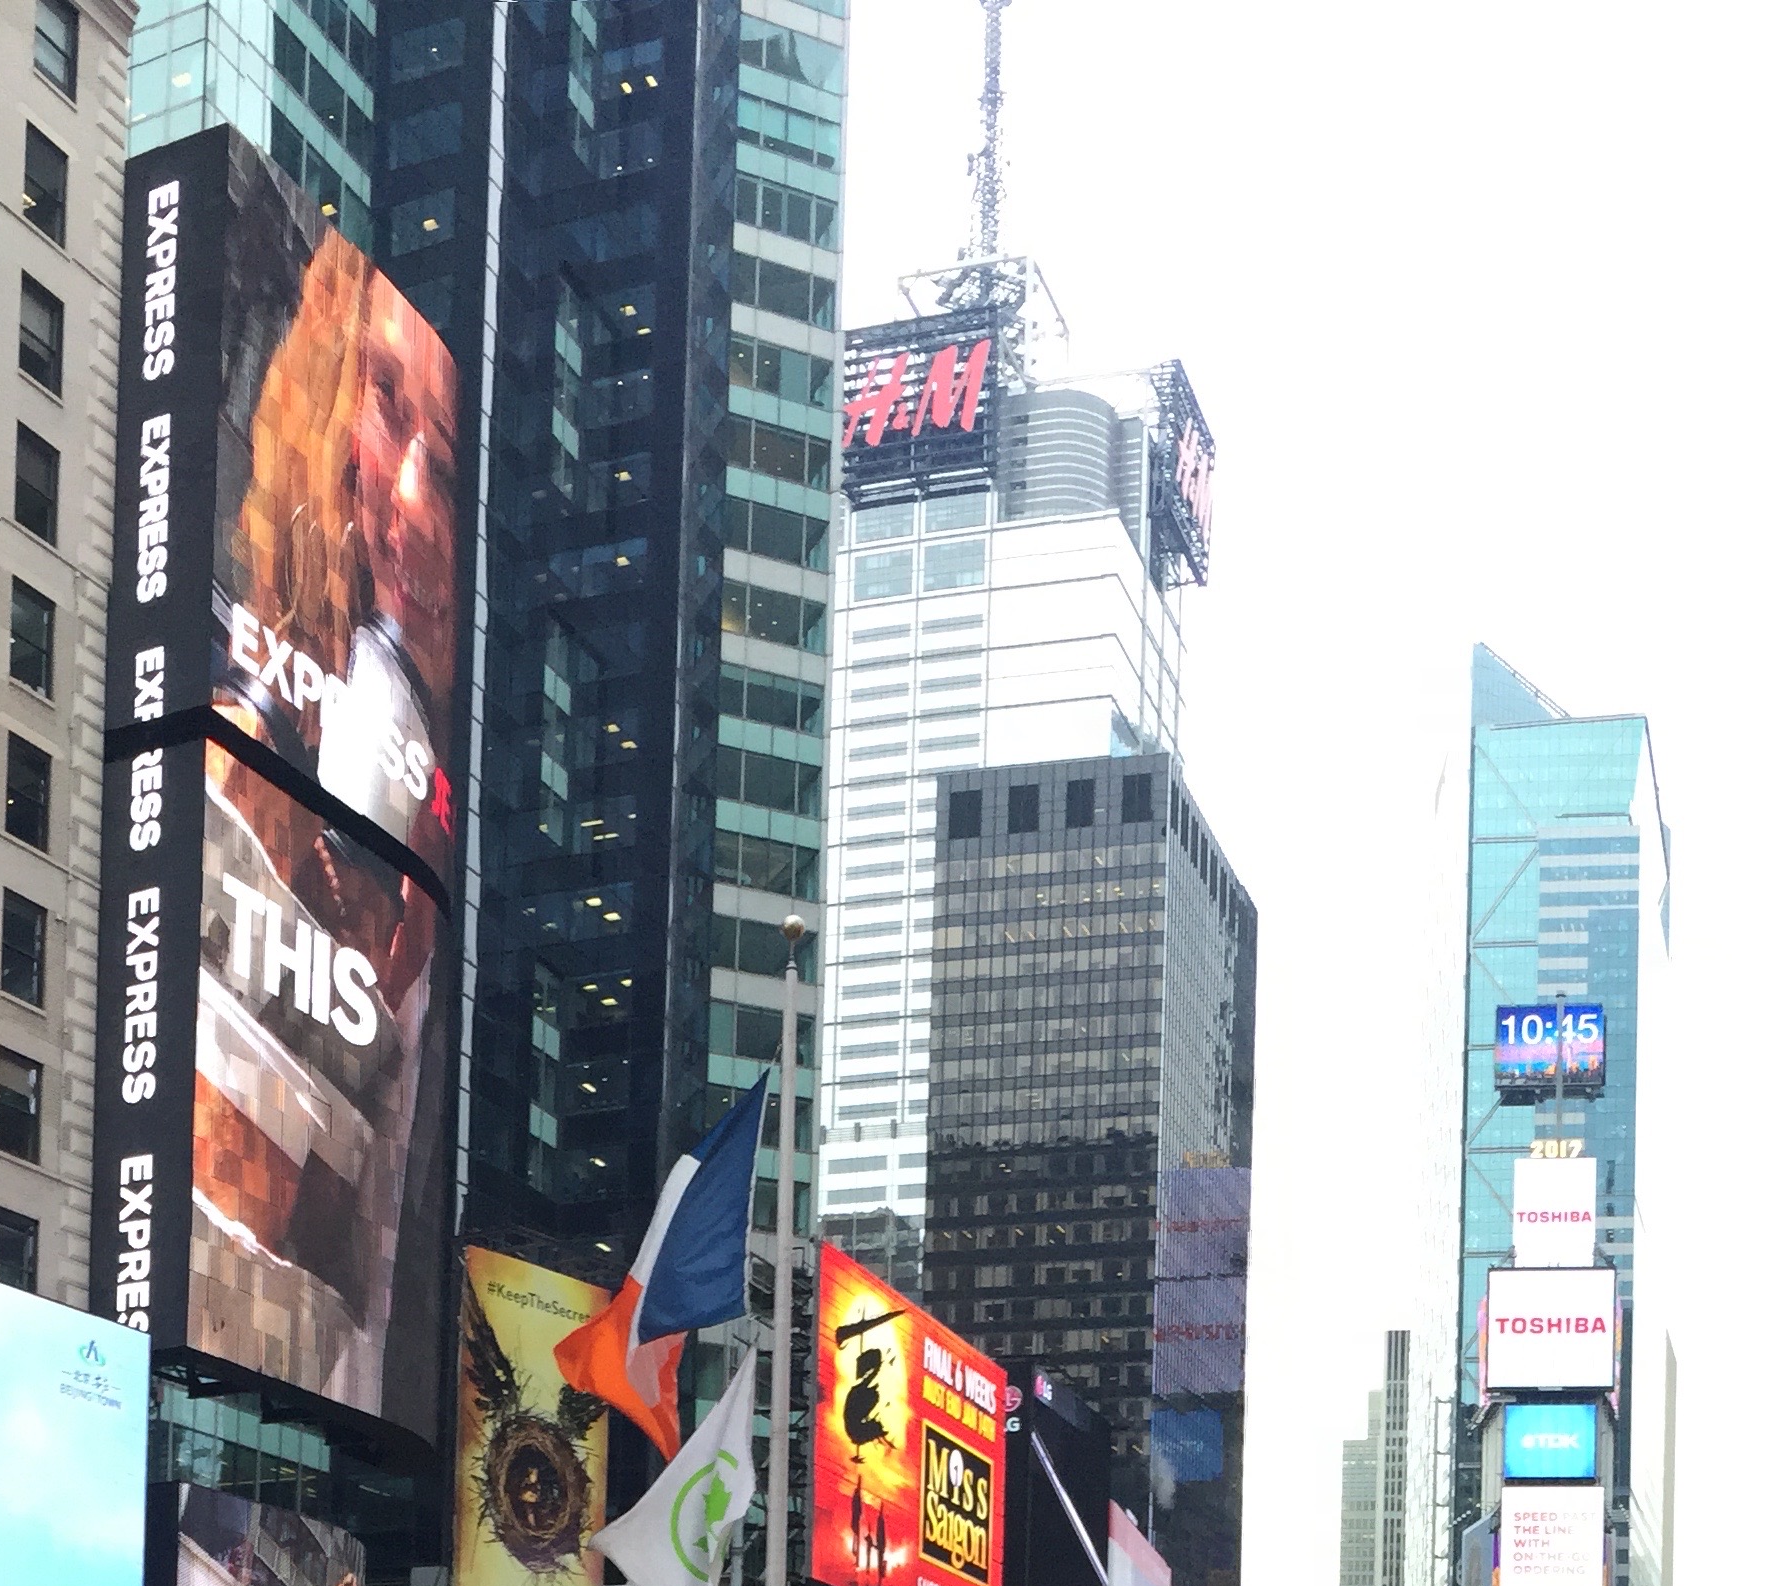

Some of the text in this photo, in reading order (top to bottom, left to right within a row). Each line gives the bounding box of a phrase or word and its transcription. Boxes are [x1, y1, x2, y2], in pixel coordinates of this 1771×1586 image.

[142, 180, 179, 381] EXPRESS
[842, 338, 991, 447] H&M
[136, 412, 170, 603] EXPRESS
[223, 872, 378, 1046] THIS
[122, 888, 160, 1103] EXPRESS
[1530, 1140, 1581, 1158] 2017
[1518, 1211, 1591, 1223] TOSHIBA
[1496, 1318, 1606, 1334] TOSHIBA
[1514, 1526, 1574, 1534] THE LINE
[1514, 1539, 1549, 1547] WITH
